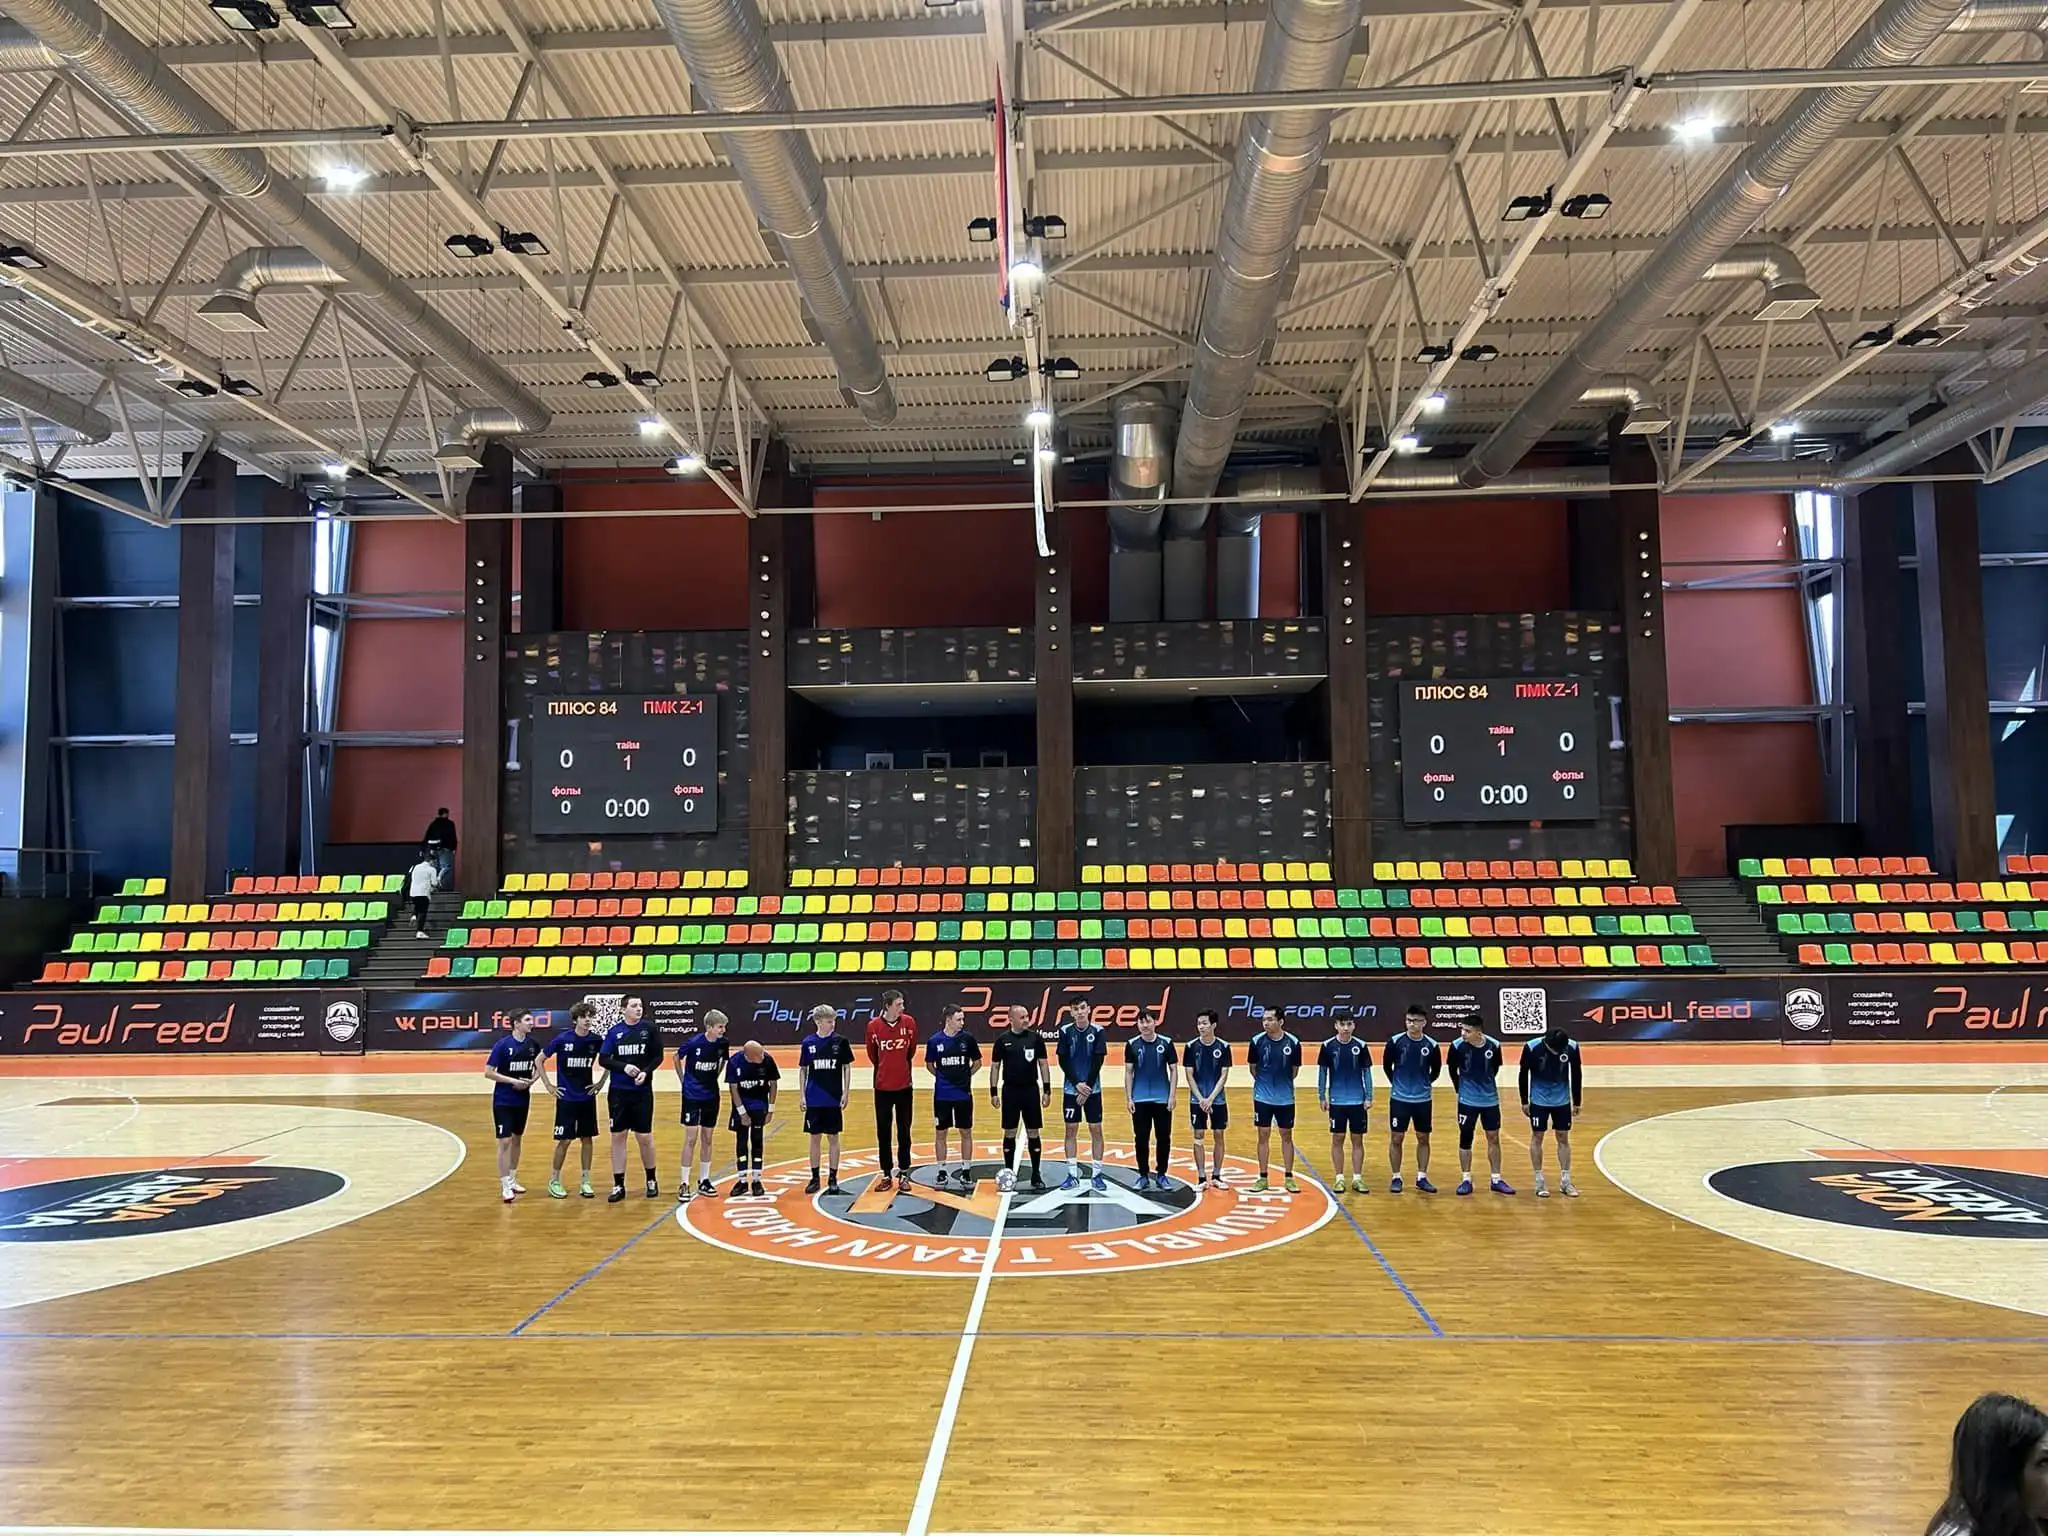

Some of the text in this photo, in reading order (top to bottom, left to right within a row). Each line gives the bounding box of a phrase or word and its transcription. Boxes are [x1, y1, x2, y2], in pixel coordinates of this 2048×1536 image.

[1414, 685, 1489, 700] ПЛЮС 84
[1515, 683, 1580, 698] ПМК Z-1
[547, 701, 618, 716] ПЛЮС 84
[643, 700, 704, 714] ПМК Z-1
[1430, 734, 1445, 755] 0
[1497, 739, 1506, 757] 1
[1559, 732, 1574, 752] 0
[560, 749, 573, 769] 0
[623, 754, 631, 771] 1
[682, 748, 696, 768] 0
[1423, 773, 1455, 784] фолы
[1552, 770, 1584, 782] фолы
[551, 784, 582, 797] фолы
[674, 784, 704, 796] фолы
[1433, 787, 1445, 802] 0
[1480, 784, 1528, 805] 0:00
[1563, 785, 1575, 799] 0
[560, 800, 572, 814] 0
[604, 798, 650, 818] 0:00
[683, 799, 694, 813] 0
[752, 999, 802, 1031] Play
[1611, 1000, 1752, 1025] paul_feed
[1926, 986, 2031, 1029] Paul
[23, 1004, 119, 1045] Paul
[121, 1003, 235, 1044] Feed
[1065, 1108, 1075, 1119] 77
[1392, 1117, 1398, 1128] 8
[1532, 1116, 1540, 1127] 11
[554, 1126, 564, 1136] 20
[0, 1174, 204, 1230] ARENA
[83, 1177, 278, 1224] NOVA
[1809, 1173, 1977, 1221] NOVA
[1866, 1169, 2048, 1224] ARENA
[723, 1205, 839, 1249] HARD
[1068, 1204, 1291, 1262] HUMBLE
[826, 1238, 1052, 1265] TRAIN
